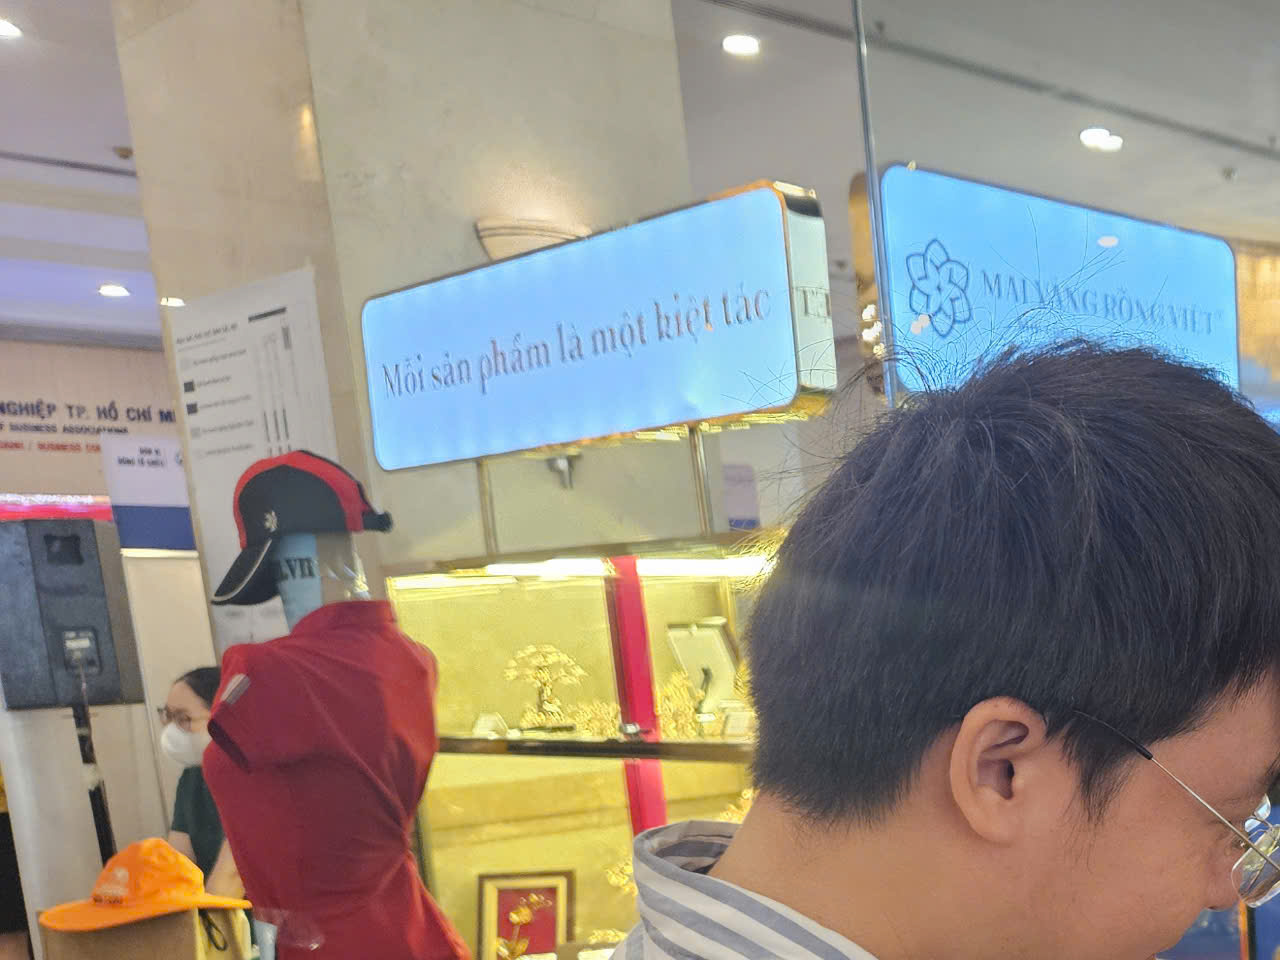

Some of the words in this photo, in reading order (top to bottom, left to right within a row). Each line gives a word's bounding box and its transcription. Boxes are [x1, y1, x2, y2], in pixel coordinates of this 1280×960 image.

[382, 352, 426, 399] Mỗi
[431, 351, 473, 391] sản
[479, 332, 552, 396] phẩm
[556, 320, 585, 364] là
[591, 311, 647, 359] một
[653, 292, 711, 343] kiệt
[721, 282, 770, 326] tác
